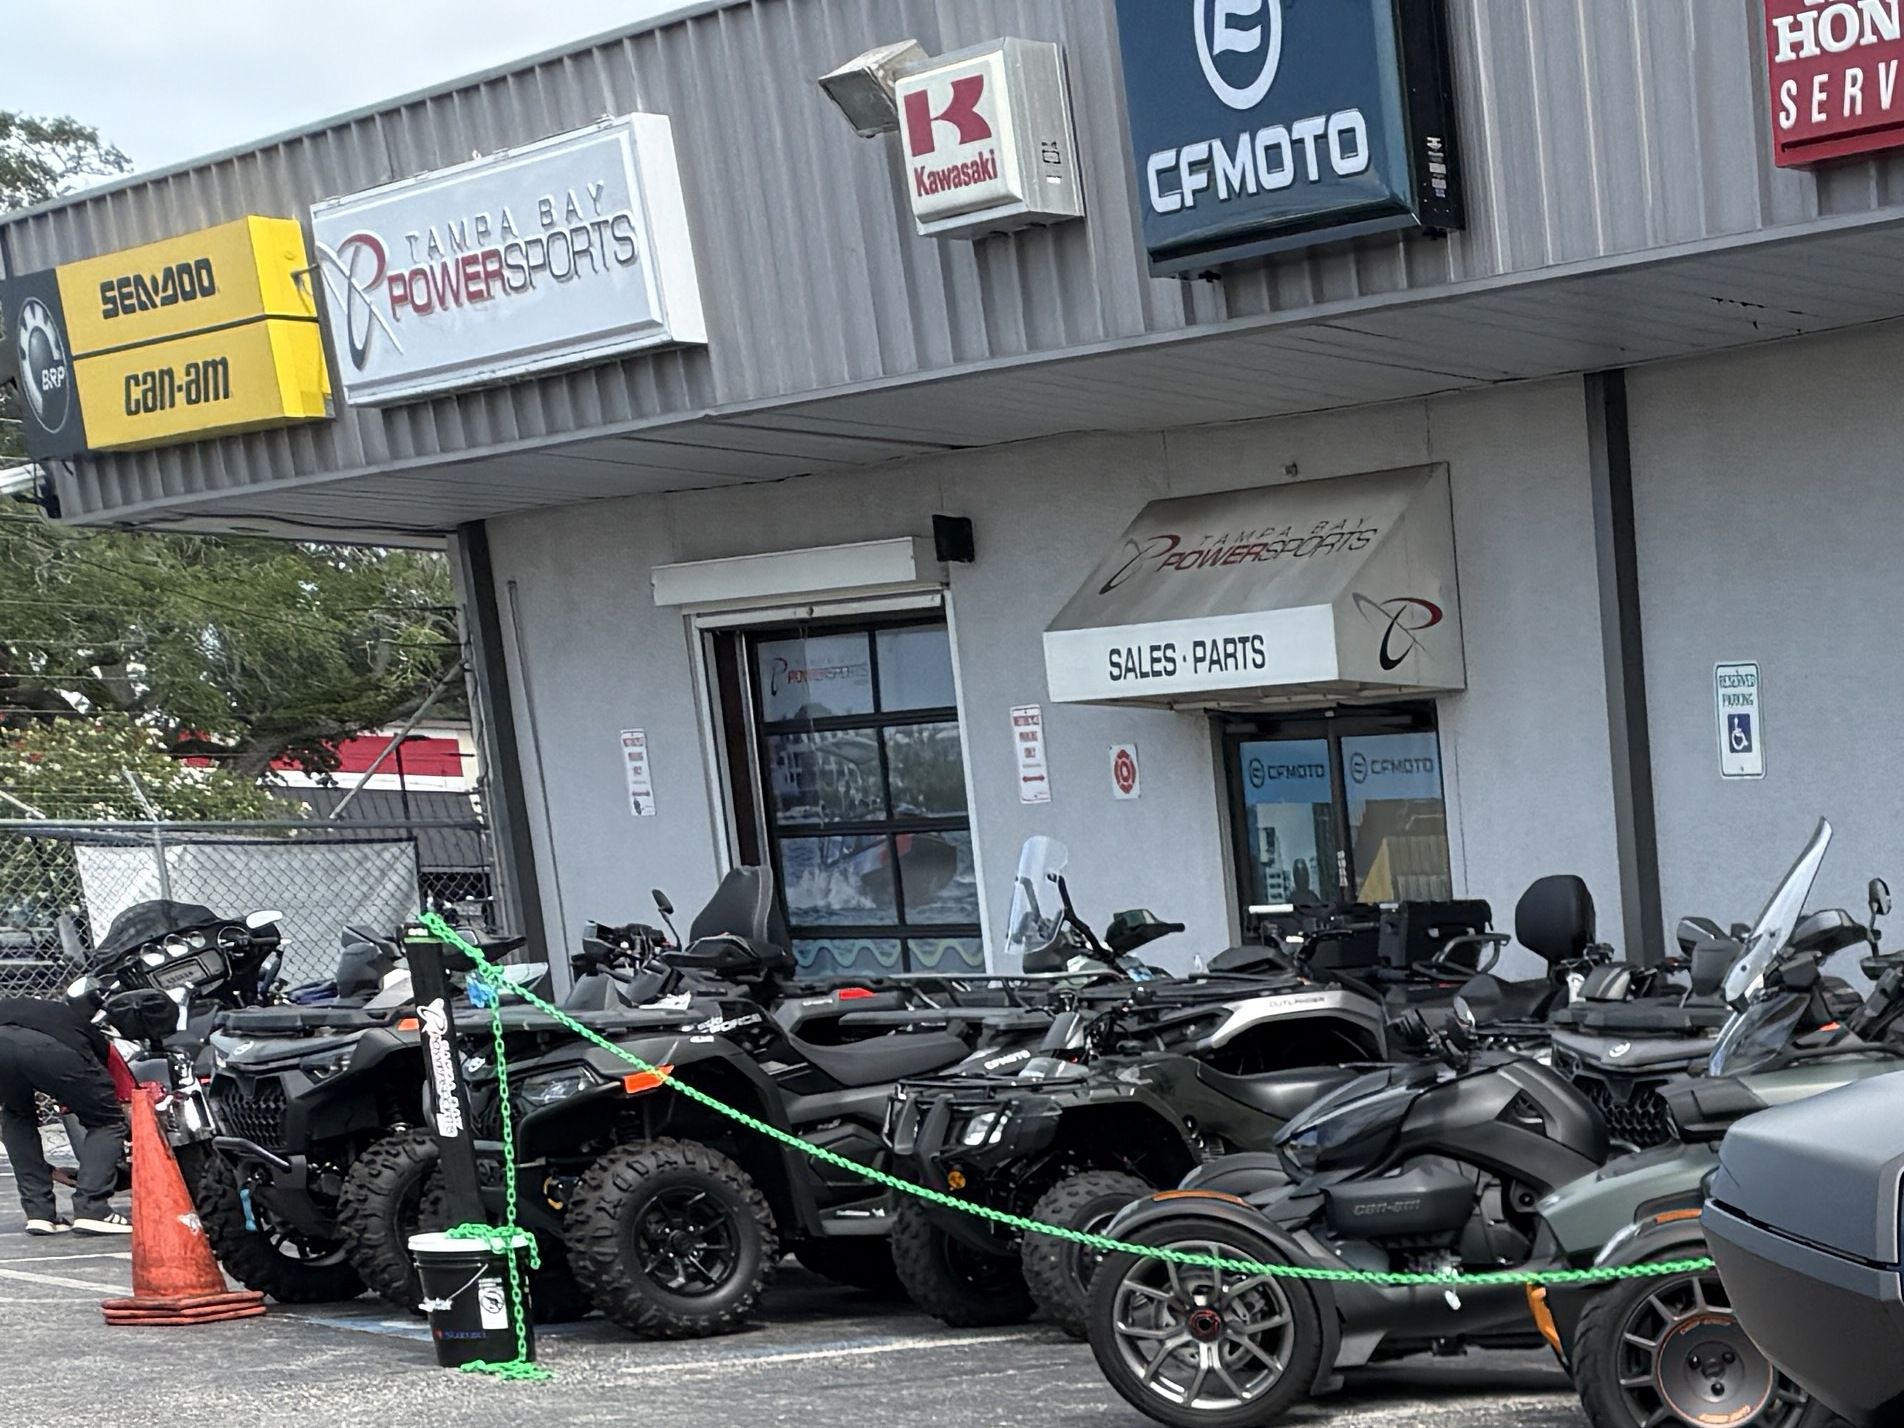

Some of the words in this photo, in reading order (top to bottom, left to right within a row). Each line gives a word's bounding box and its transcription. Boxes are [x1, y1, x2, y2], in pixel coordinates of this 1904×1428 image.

[914, 148, 998, 197] Kawasaki
[1146, 107, 1369, 213] CFMOTO
[404, 205, 520, 264] TAMPA
[538, 179, 605, 228] BAY
[388, 211, 638, 322] POWERSPORTS
[41, 364, 67, 391] BRP
[124, 355, 231, 417] can-am
[1155, 528, 1378, 573] POWERSPORTS
[1199, 525, 1292, 547] TAMPA
[1311, 516, 1375, 535] BAY
[1108, 643, 1177, 682] SALES
[1193, 634, 1266, 674] PARTS
[1267, 763, 1326, 780] CFMOTO
[1370, 757, 1434, 775] CFMOTO
